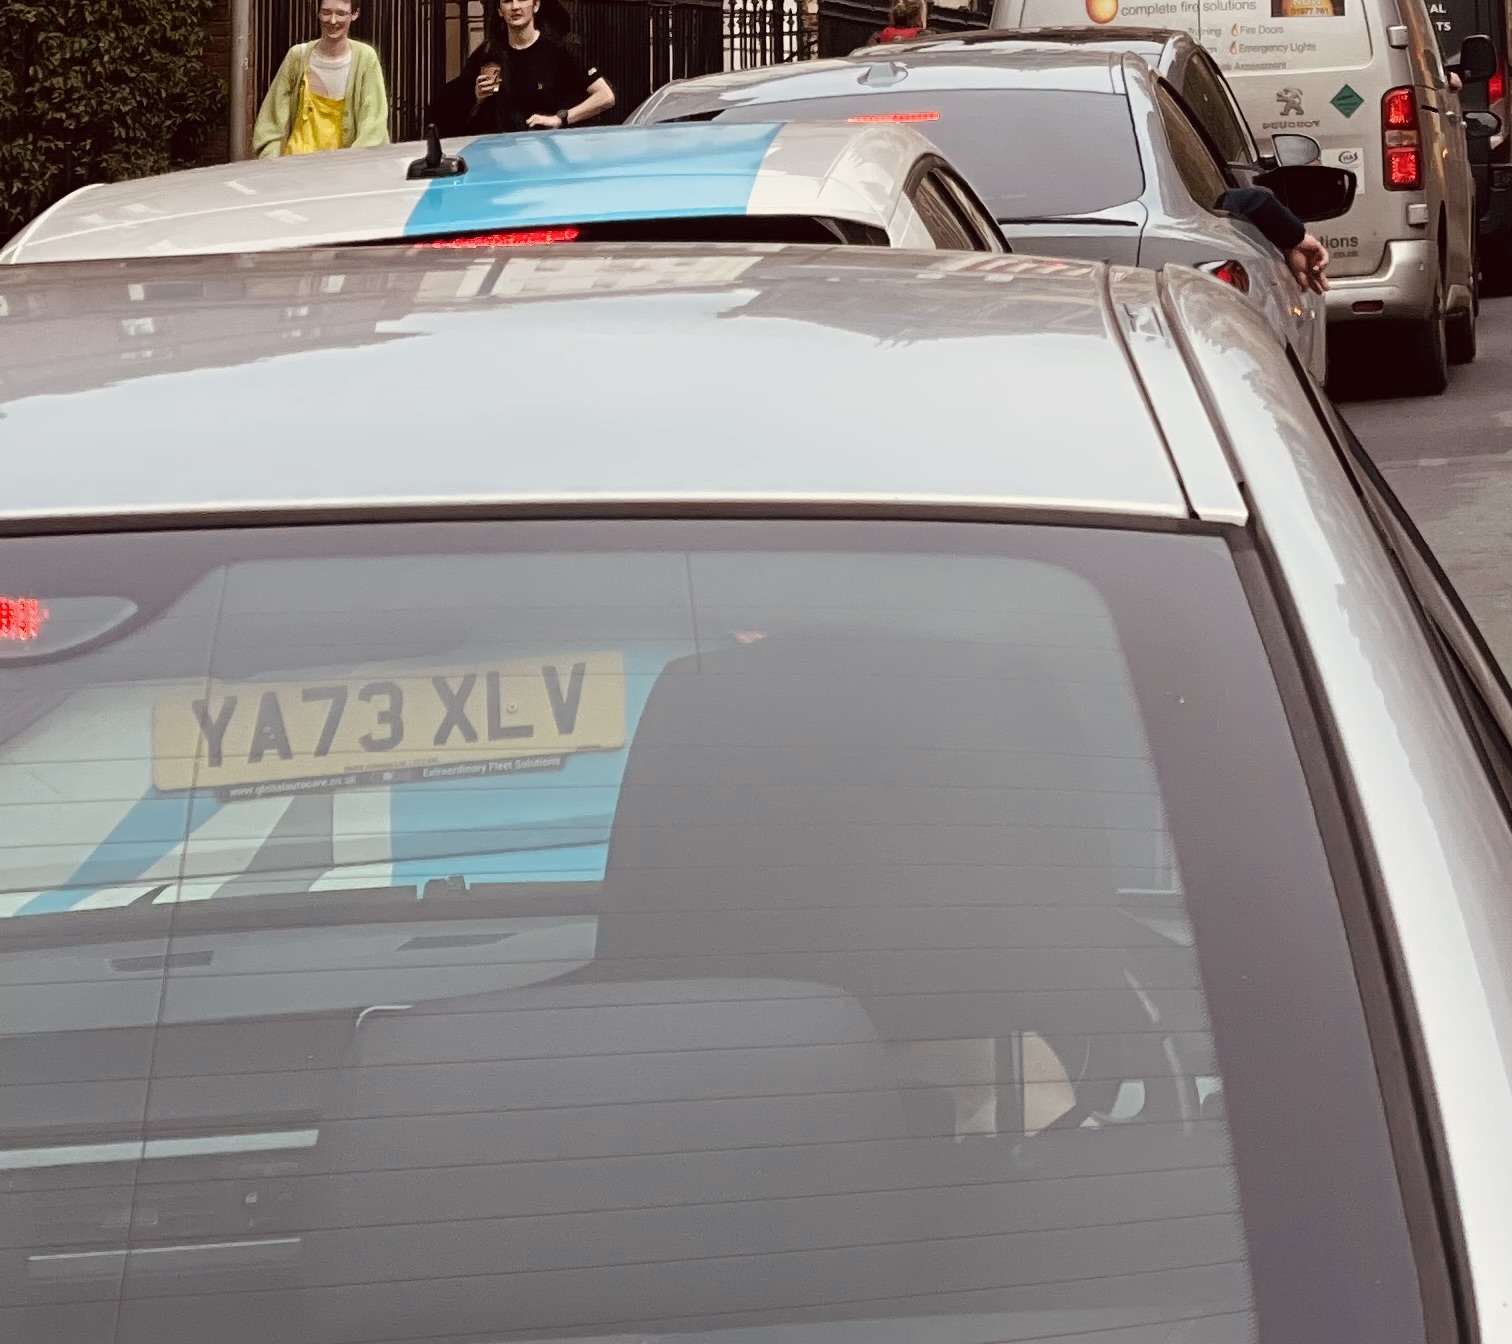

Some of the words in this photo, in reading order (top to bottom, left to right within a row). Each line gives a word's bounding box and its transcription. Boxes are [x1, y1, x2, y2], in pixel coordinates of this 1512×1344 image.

[1121, 2, 1177, 17] complete
[1181, 1, 1199, 13] fire
[1202, 0, 1257, 12] solutions
[1262, 120, 1321, 130] PEUGEOT
[191, 680, 405, 768] YA73
[431, 662, 587, 747] XLV
[423, 763, 486, 778] Extraordinary
[489, 760, 513, 773] Fleet
[515, 756, 561, 770] Solutions
